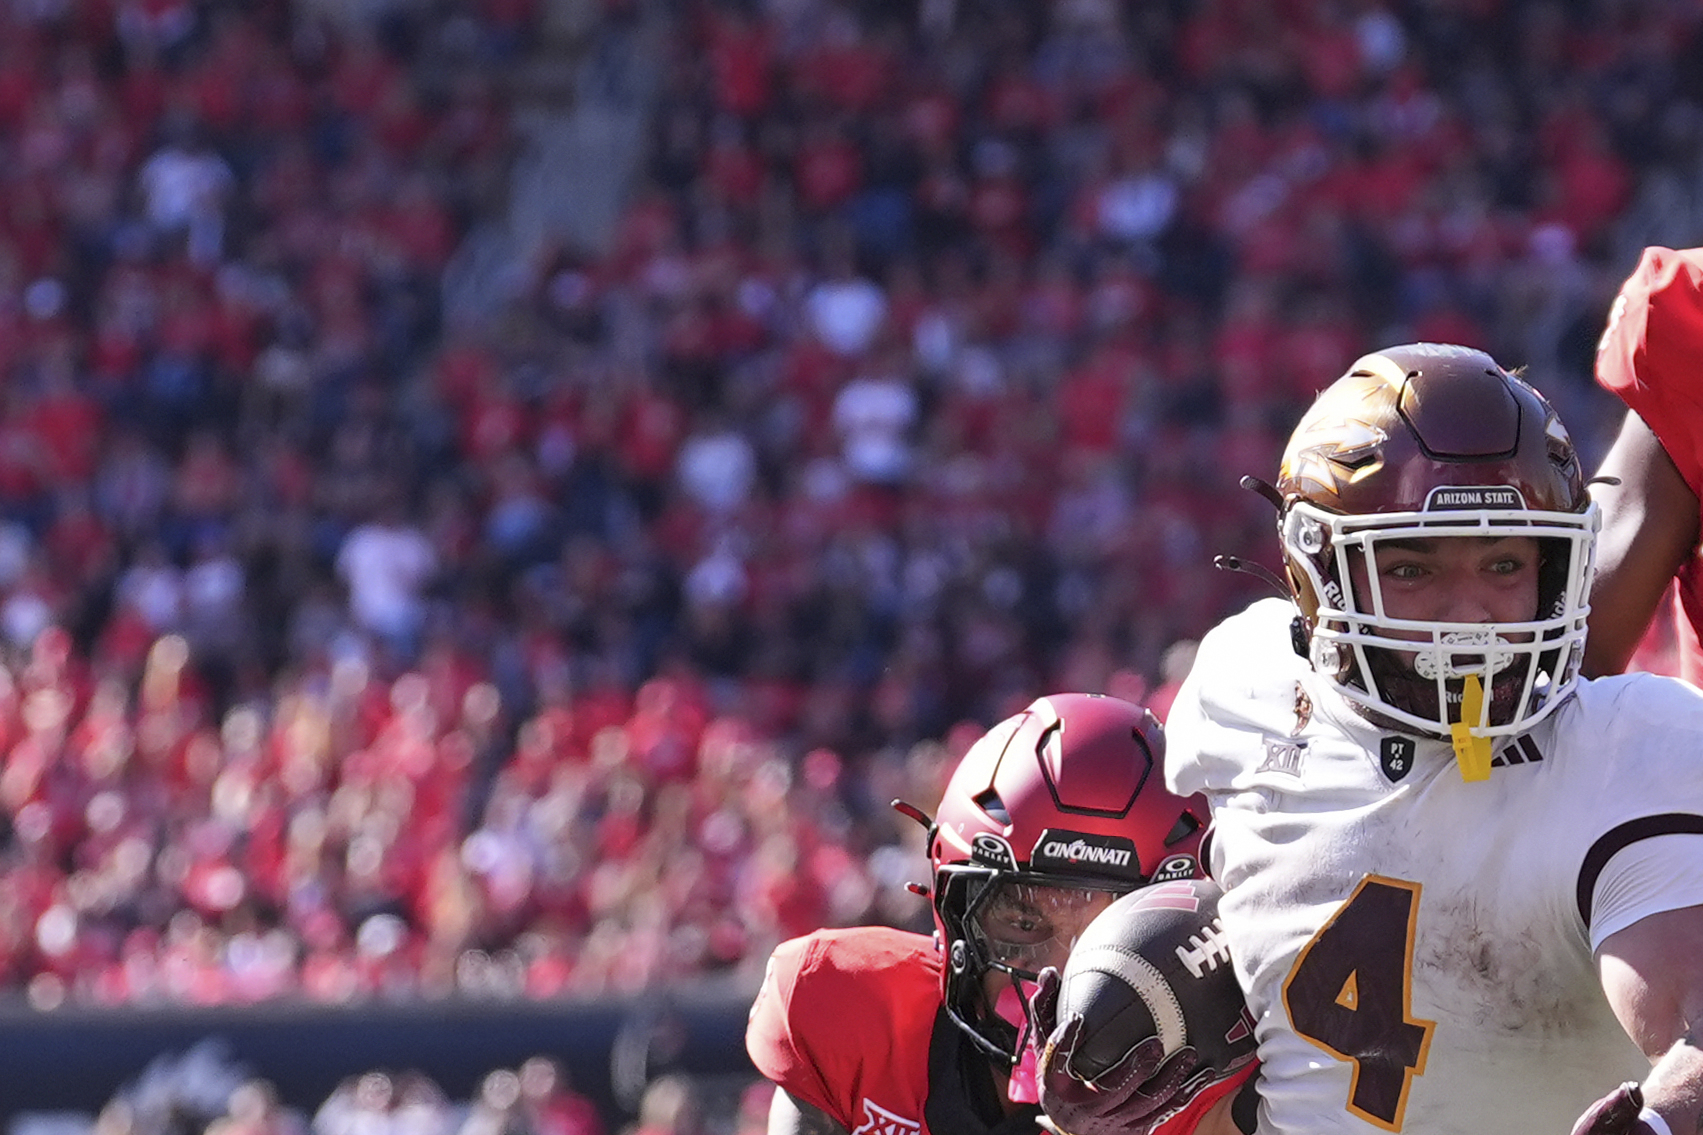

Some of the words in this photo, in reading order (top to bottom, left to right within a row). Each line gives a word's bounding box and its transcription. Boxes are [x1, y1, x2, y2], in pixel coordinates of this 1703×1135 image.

[1436, 492, 1483, 505] ARIZONA
[1484, 492, 1515, 504] STATE
[1390, 743, 1405, 755] PT
[1389, 759, 1404, 771] 42
[1043, 839, 1132, 867] CINCINNATI
[1157, 868, 1194, 881] OAKLEY
[1281, 872, 1437, 1134] 4
